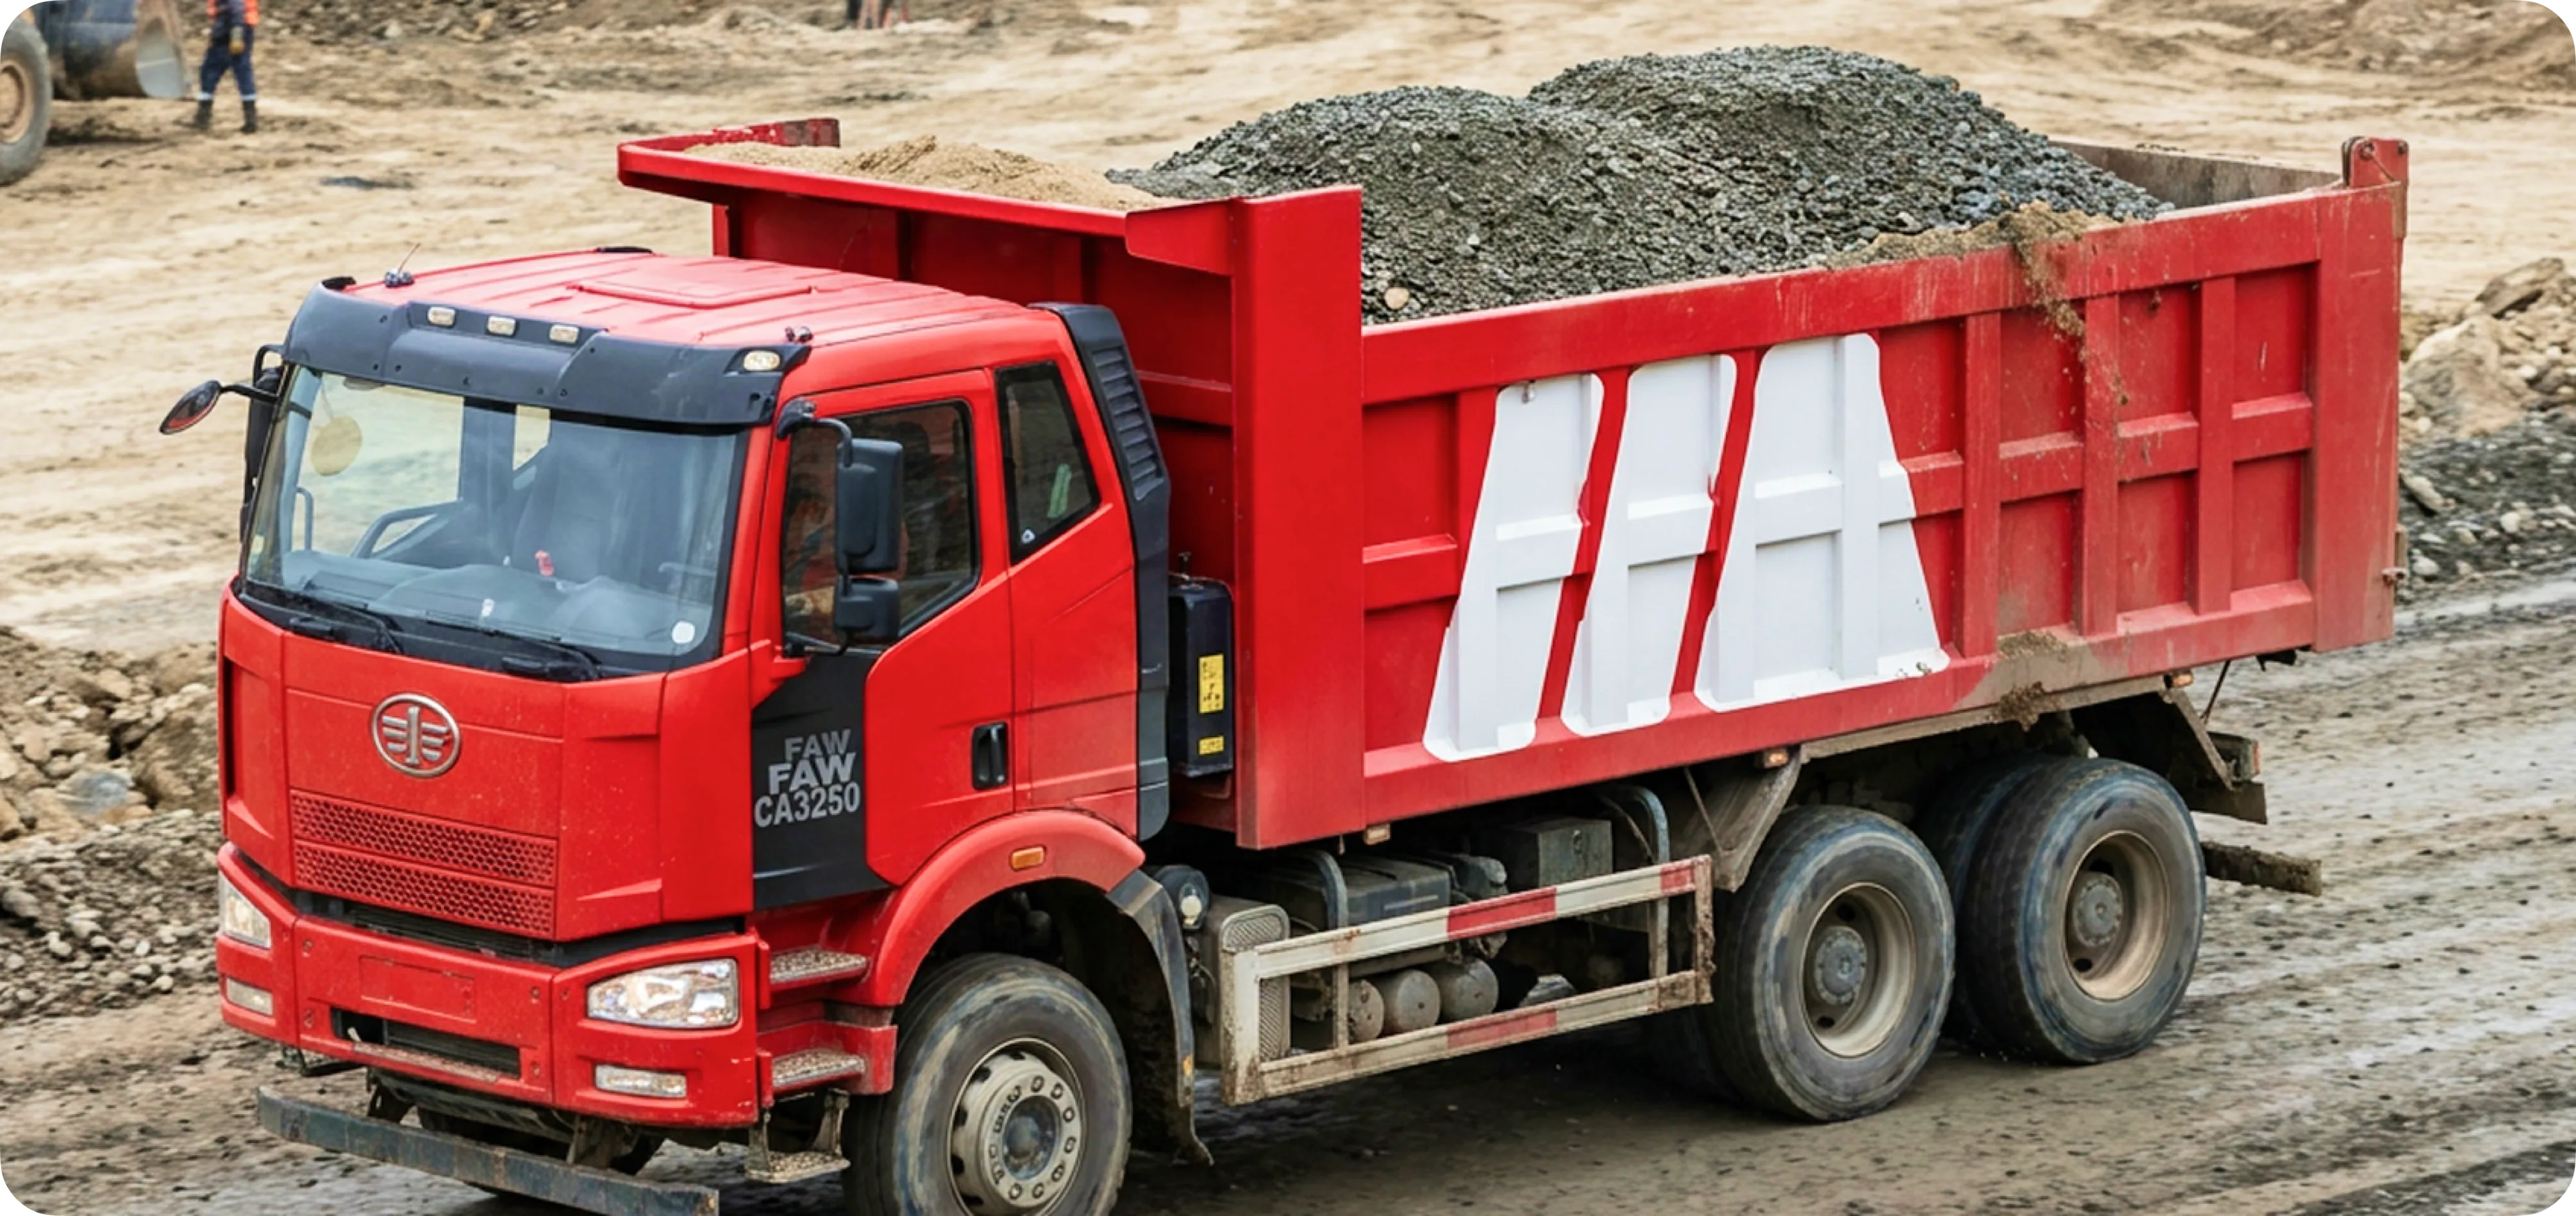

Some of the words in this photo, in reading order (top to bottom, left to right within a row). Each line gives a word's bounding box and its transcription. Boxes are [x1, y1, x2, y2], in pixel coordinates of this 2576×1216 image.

[784, 728, 851, 762] FAW
[768, 752, 857, 795] FAW
[754, 781, 861, 828] CA3250
